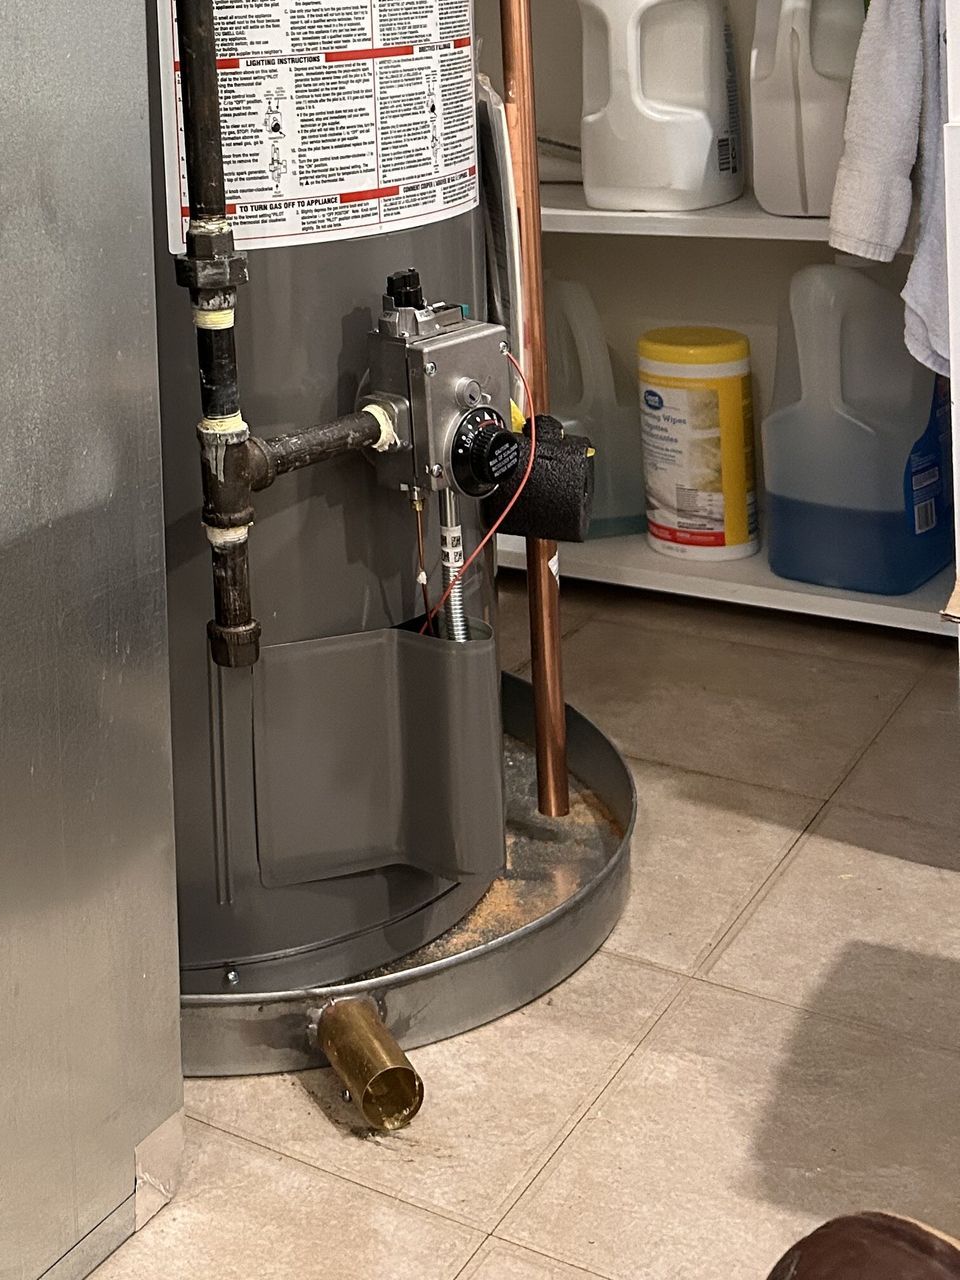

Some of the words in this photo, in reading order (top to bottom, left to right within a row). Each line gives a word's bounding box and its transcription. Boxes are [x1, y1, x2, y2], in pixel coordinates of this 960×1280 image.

[246, 59, 276, 67] LIGHTING
[277, 56, 320, 65] INSTRUCTIONS
[250, 203, 267, 211] TURN
[269, 202, 282, 210] GAS
[307, 197, 338, 206] APPLIANCE
[663, 414, 686, 424] Wipes
[464, 431, 475, 448] LOW
